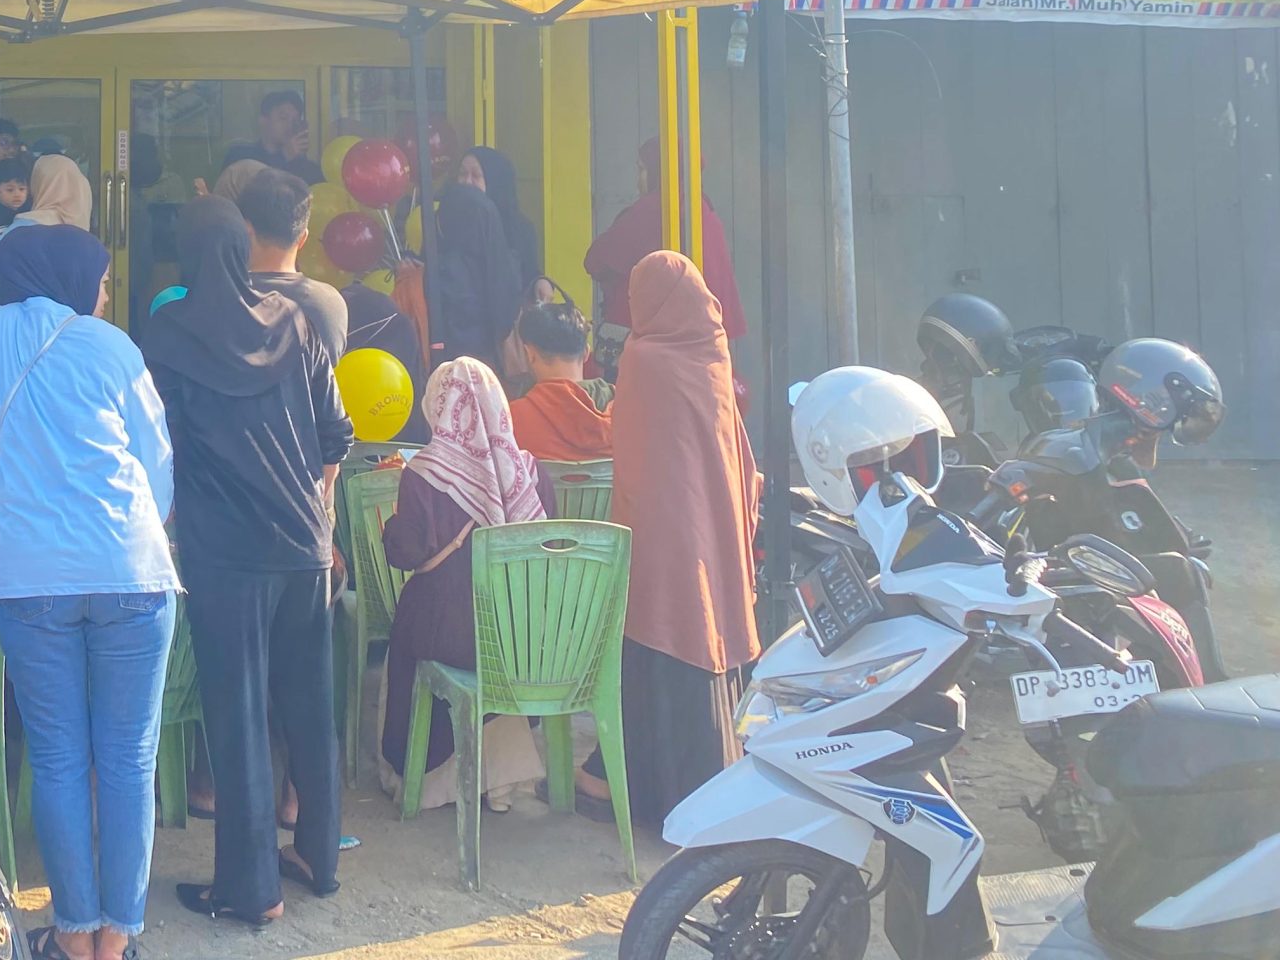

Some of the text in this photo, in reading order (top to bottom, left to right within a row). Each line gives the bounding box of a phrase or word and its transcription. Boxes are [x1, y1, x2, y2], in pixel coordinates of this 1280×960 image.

[1130, 0, 1194, 14] Yamin
[1016, 676, 1040, 696] DP
[1060, 669, 1110, 690] 3383
[795, 742, 855, 760] HONDA
